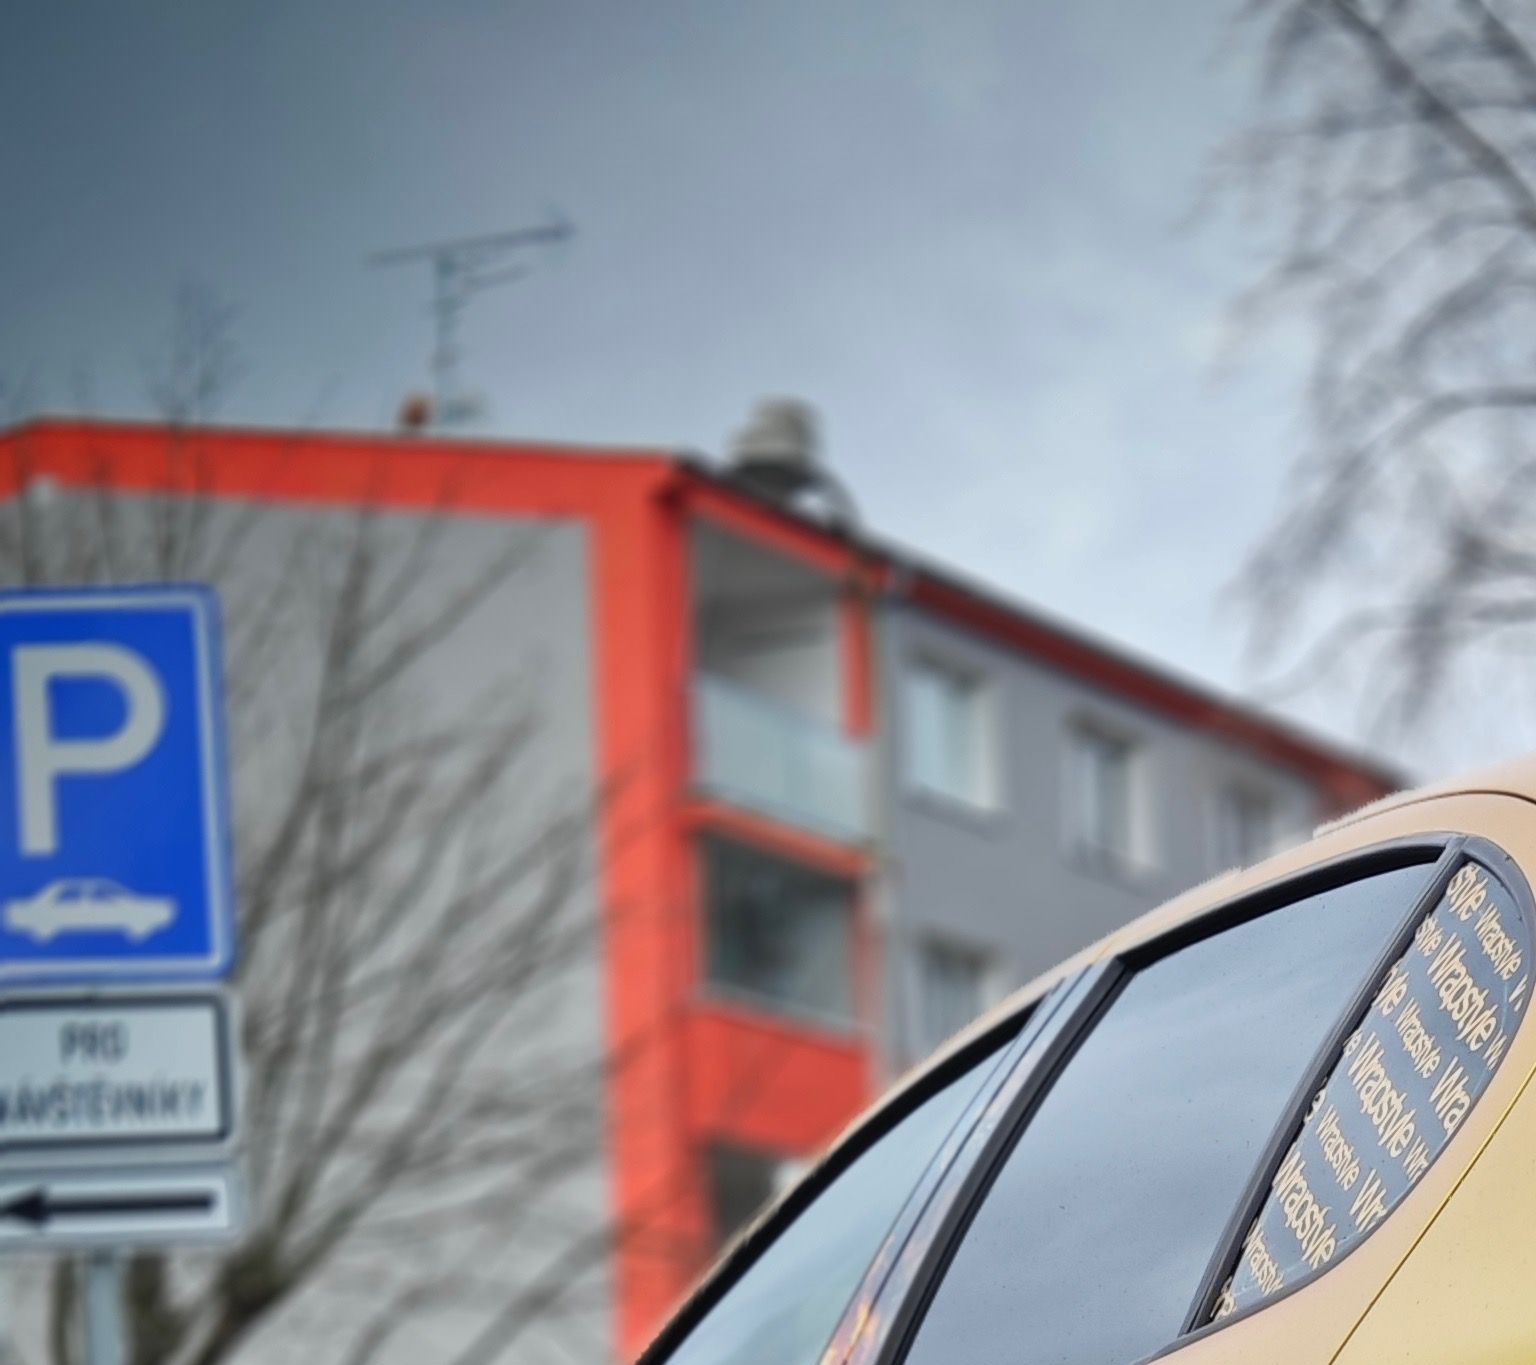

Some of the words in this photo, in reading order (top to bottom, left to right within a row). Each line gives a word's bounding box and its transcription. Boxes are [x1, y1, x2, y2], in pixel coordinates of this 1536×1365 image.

[11, 641, 168, 857] P
[1427, 932, 1499, 1051] Wrapstyle
[1347, 1031, 1416, 1158] Wrapstyle
